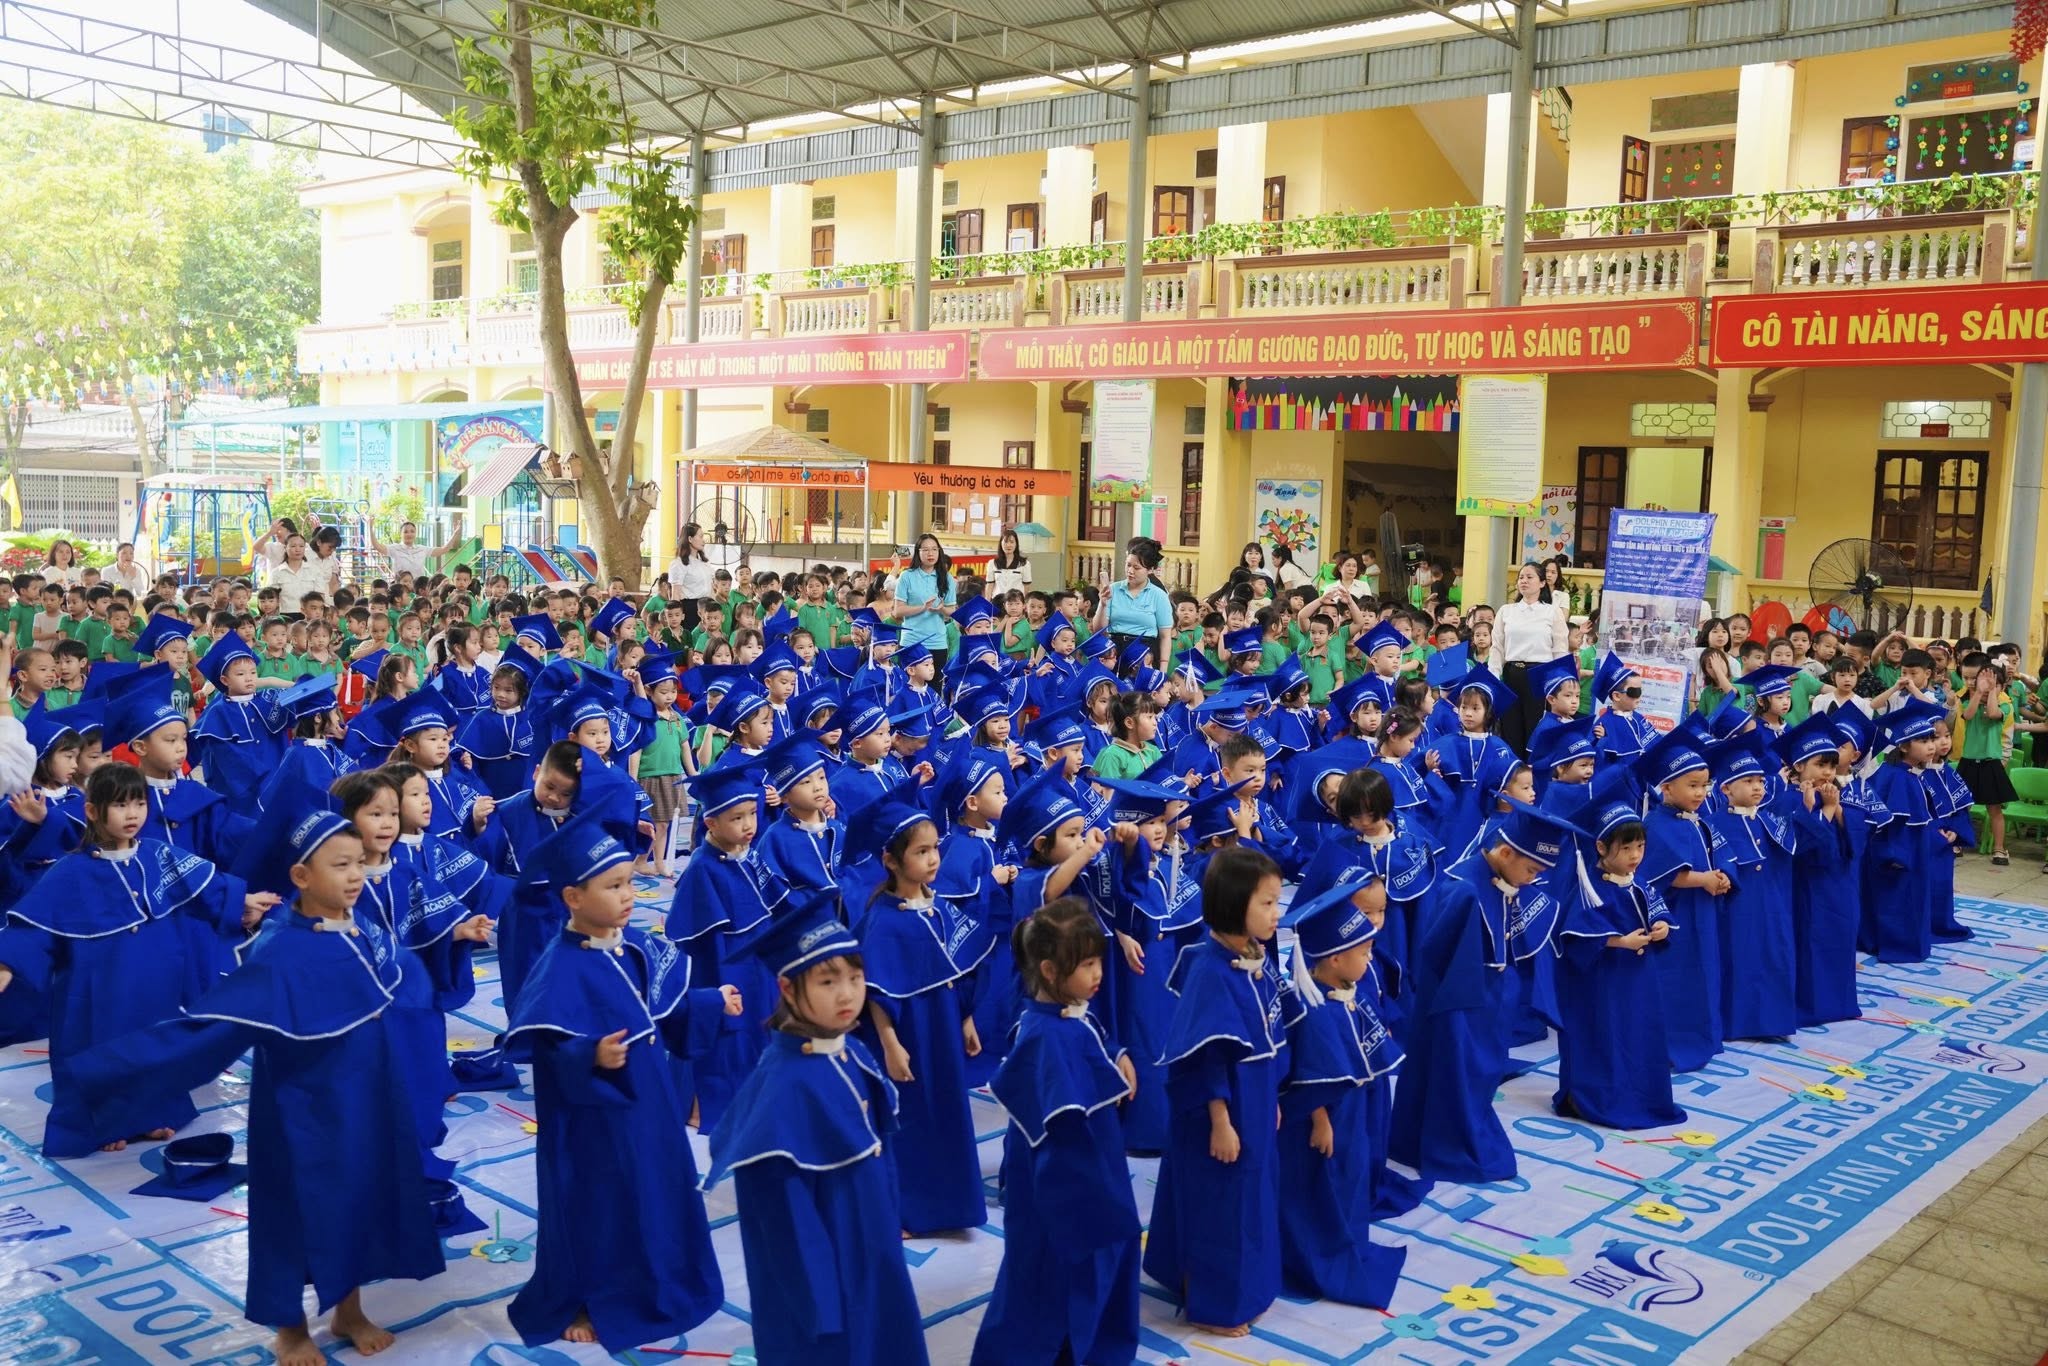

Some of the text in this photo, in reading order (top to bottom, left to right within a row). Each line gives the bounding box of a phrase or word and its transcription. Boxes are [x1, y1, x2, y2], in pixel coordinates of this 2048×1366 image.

[1743, 312, 1782, 347] CÔ
[1792, 310, 1838, 346] TÀI
[1847, 307, 1948, 346] NĂNG,
[660, 358, 674, 379] SẼ
[719, 355, 756, 377] TRONG
[759, 351, 784, 379] MỘT
[787, 350, 811, 374] MÔI
[815, 346, 864, 372] TRƯỜNG
[868, 347, 902, 371] THÂN
[1047, 336, 1085, 370] THẦY,
[1088, 338, 1109, 367] CÔ
[1113, 337, 1149, 366] GIÁO
[1152, 335, 1172, 365] LÀ
[1176, 334, 1214, 371] MỘT
[1217, 328, 1253, 363] TẤM
[1258, 333, 1318, 364] GƯƠNG
[1323, 334, 1361, 368] ĐẠO
[1365, 328, 1409, 363] ĐỨC,
[1415, 330, 1441, 366] TỰ
[1445, 331, 1484, 366] HỌC
[1491, 324, 1517, 358] VÀ
[1523, 322, 1582, 357] SÁNG
[1589, 324, 1631, 361] TẠO
[913, 471, 933, 486] Yêu
[994, 476, 1016, 489] chia
[293, 812, 319, 845] DOLPHIN
[1721, 1077, 2015, 1265] DOLPHIN ACADEMY
